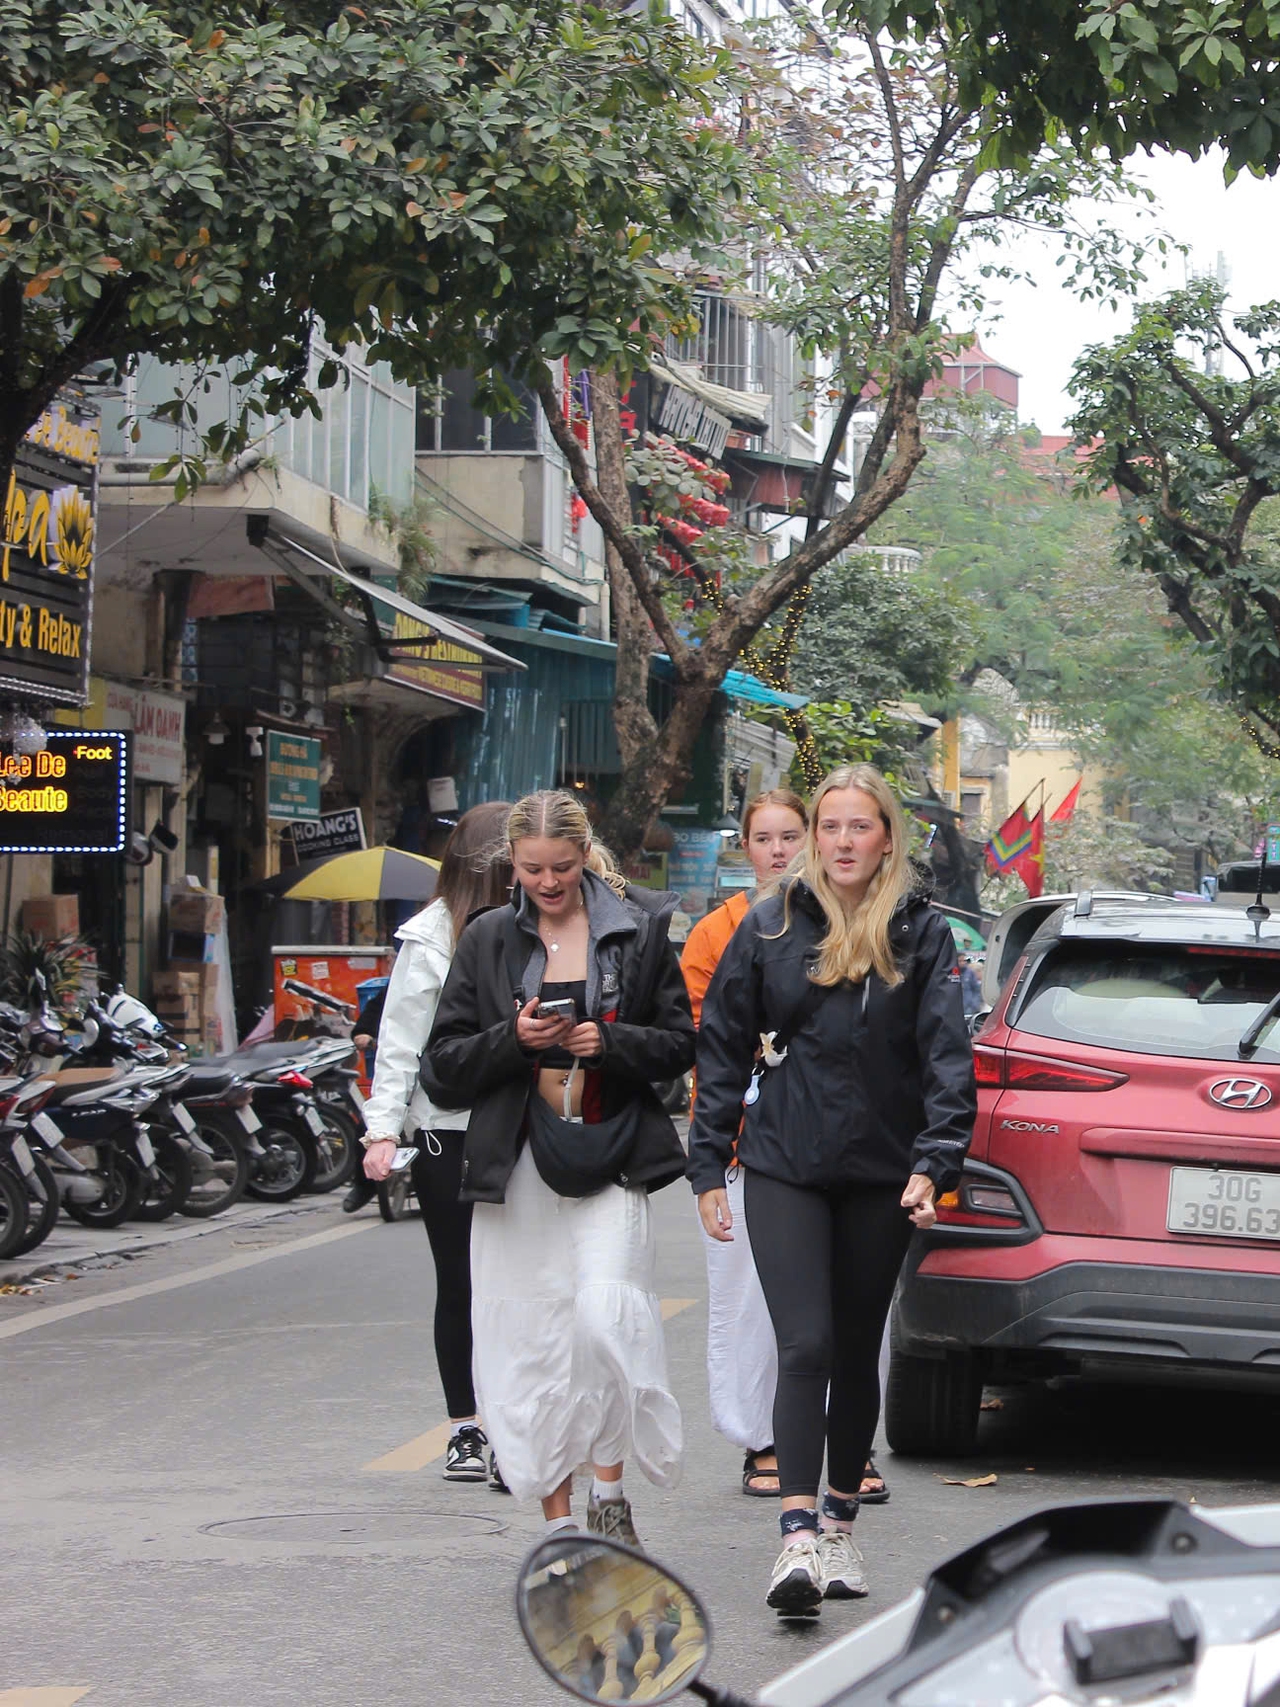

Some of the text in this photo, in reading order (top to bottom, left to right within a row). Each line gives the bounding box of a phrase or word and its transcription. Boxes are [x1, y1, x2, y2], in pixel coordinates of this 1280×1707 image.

[19, 604, 81, 658] & Relax
[36, 751, 67, 779] De
[77, 745, 113, 760] Foot
[294, 814, 357, 841] HOANG'S
[1001, 1119, 1060, 1134] KONA
[1208, 1174, 1262, 1203] 30G
